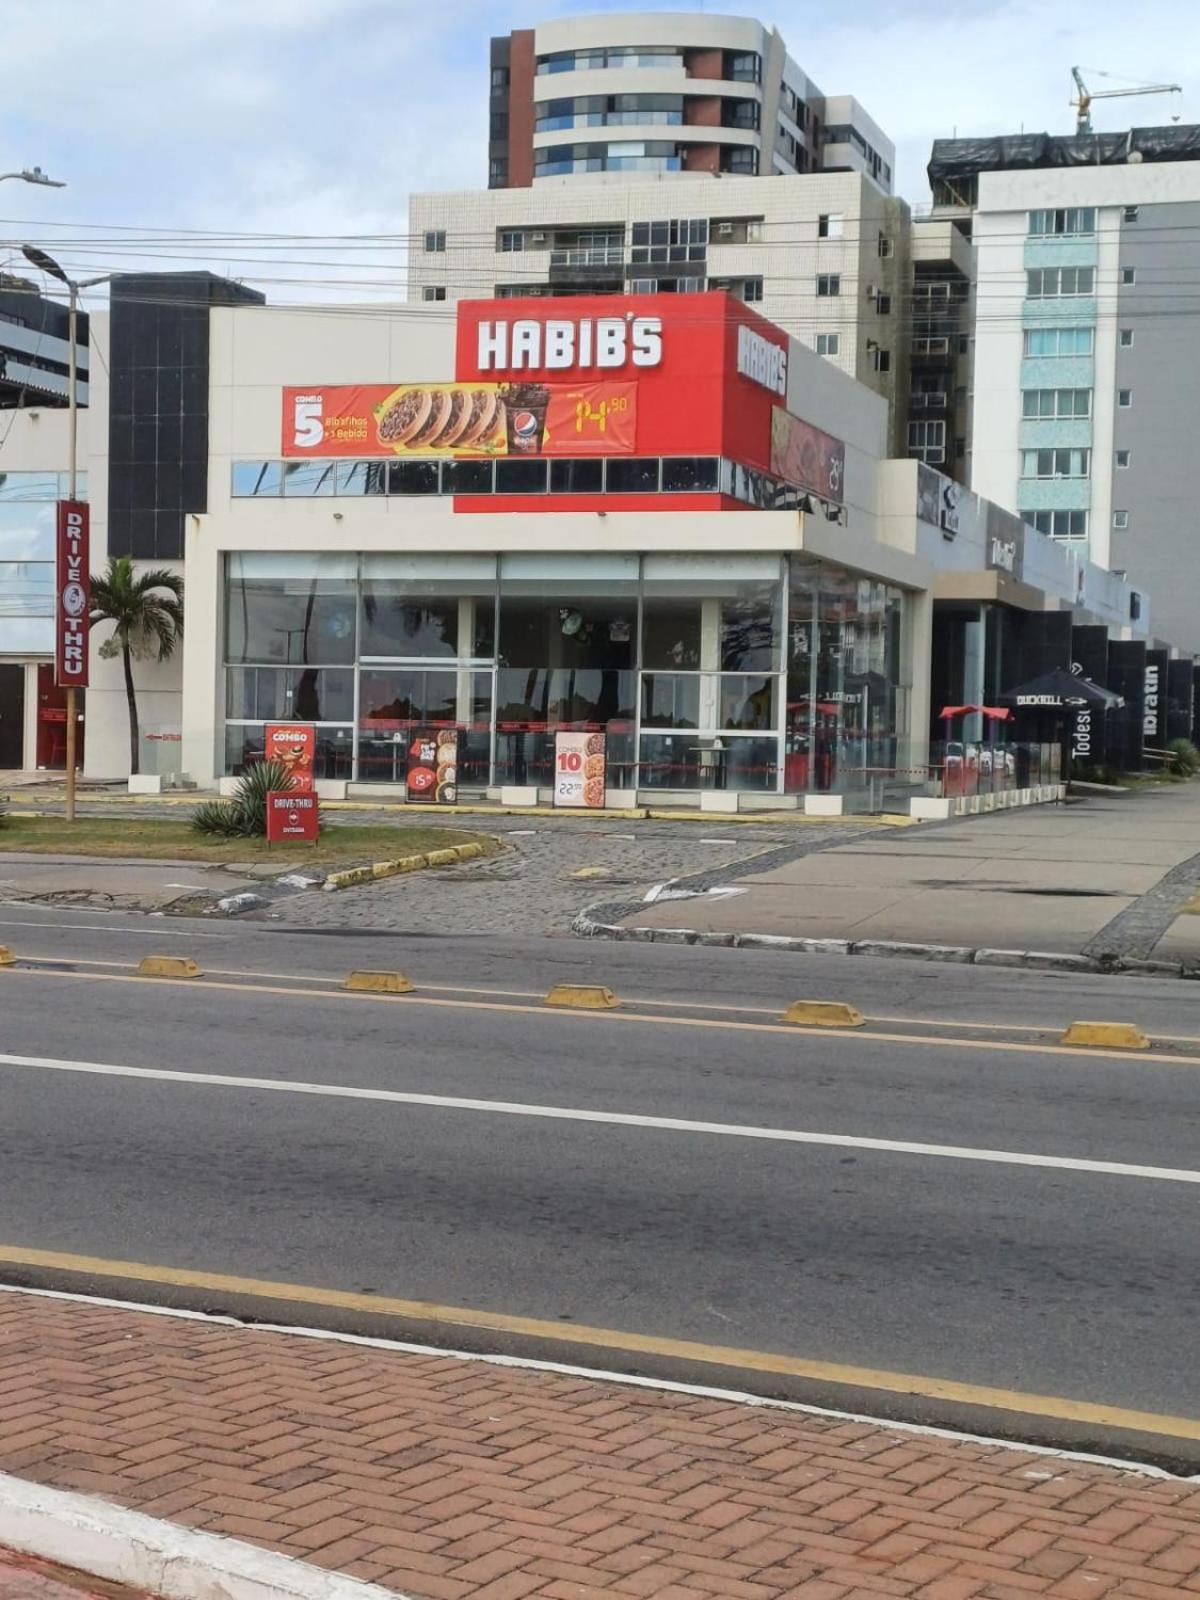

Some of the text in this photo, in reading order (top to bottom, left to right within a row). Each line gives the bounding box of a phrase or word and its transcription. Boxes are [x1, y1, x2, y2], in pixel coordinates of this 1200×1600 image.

[478, 311, 662, 370] HABIB'S
[737, 325, 787, 396] HABIB'S
[294, 403, 324, 447] 5
[64, 513, 82, 675] DRIVE THRU
[273, 733, 308, 742] COMBO
[558, 752, 582, 772] 10
